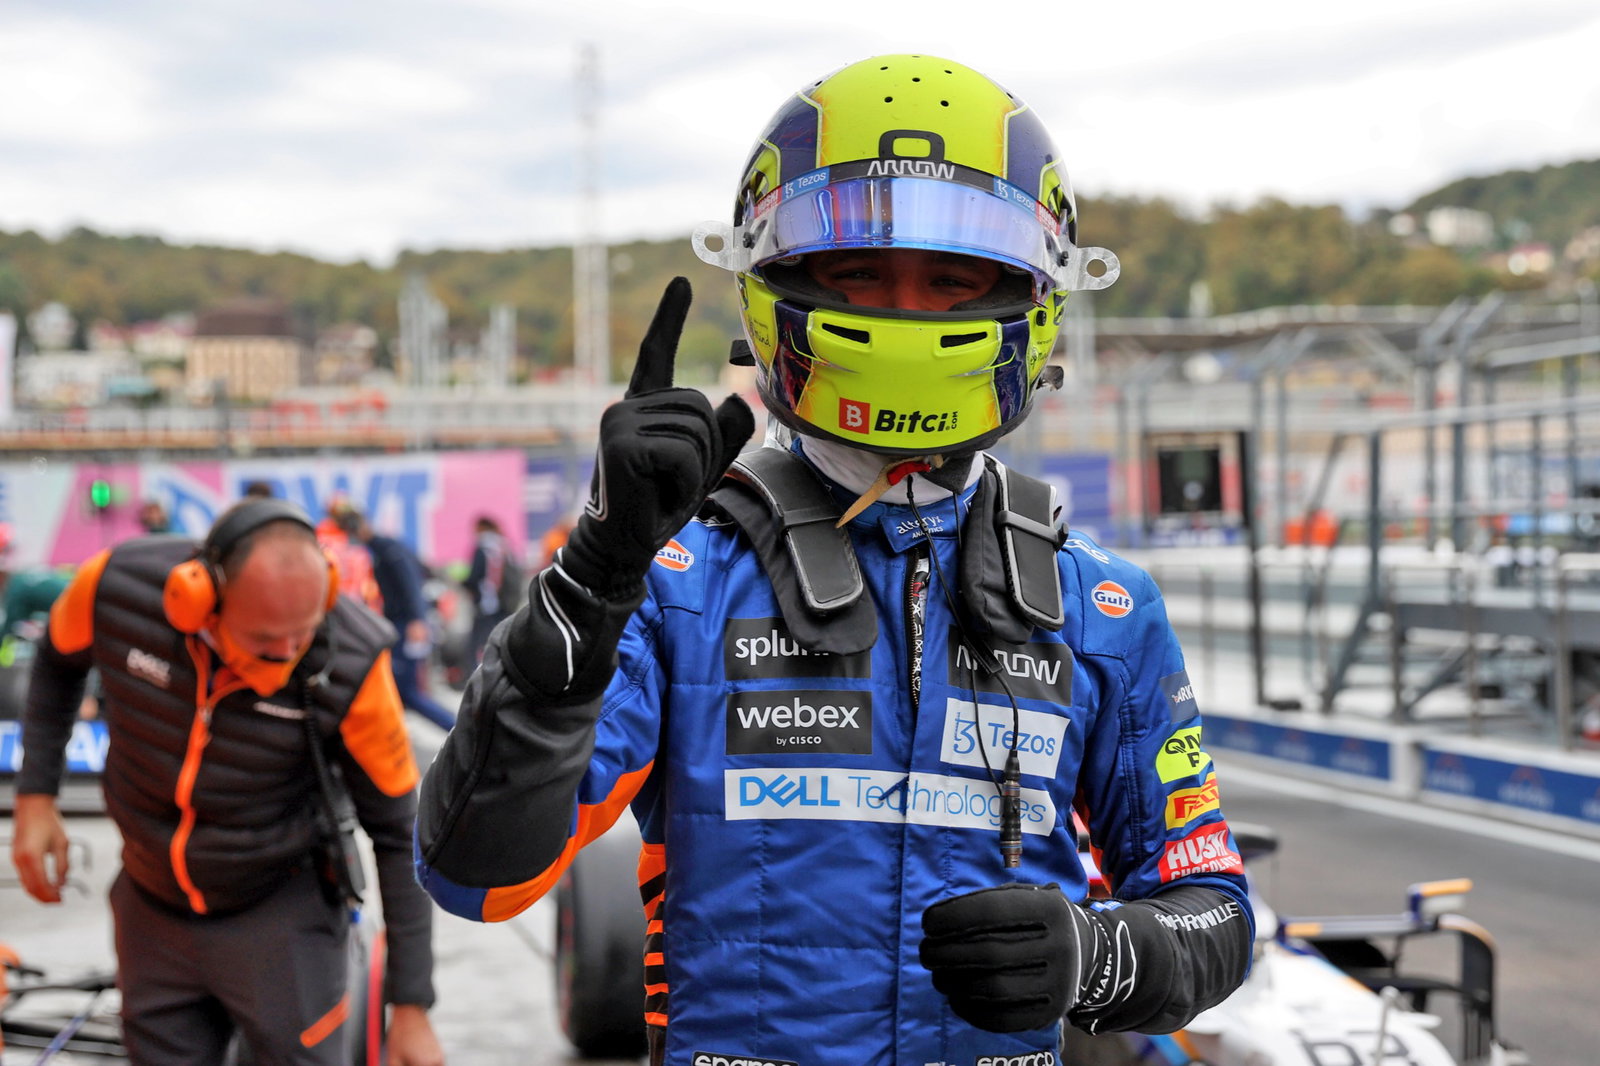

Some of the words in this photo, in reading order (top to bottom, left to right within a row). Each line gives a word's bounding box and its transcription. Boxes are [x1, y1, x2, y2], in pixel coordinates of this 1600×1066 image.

[798, 172, 827, 188] Tezos
[867, 160, 955, 180] ARROW
[1094, 591, 1131, 607] Gulf
[735, 629, 829, 666] splu
[956, 644, 1062, 685] AROW
[736, 697, 860, 729] webex
[776, 736, 787, 746] by
[789, 735, 822, 745] CISCO
[987, 722, 1056, 756] Tezos
[739, 774, 841, 808] DELL
[848, 775, 1047, 827] Technologes
